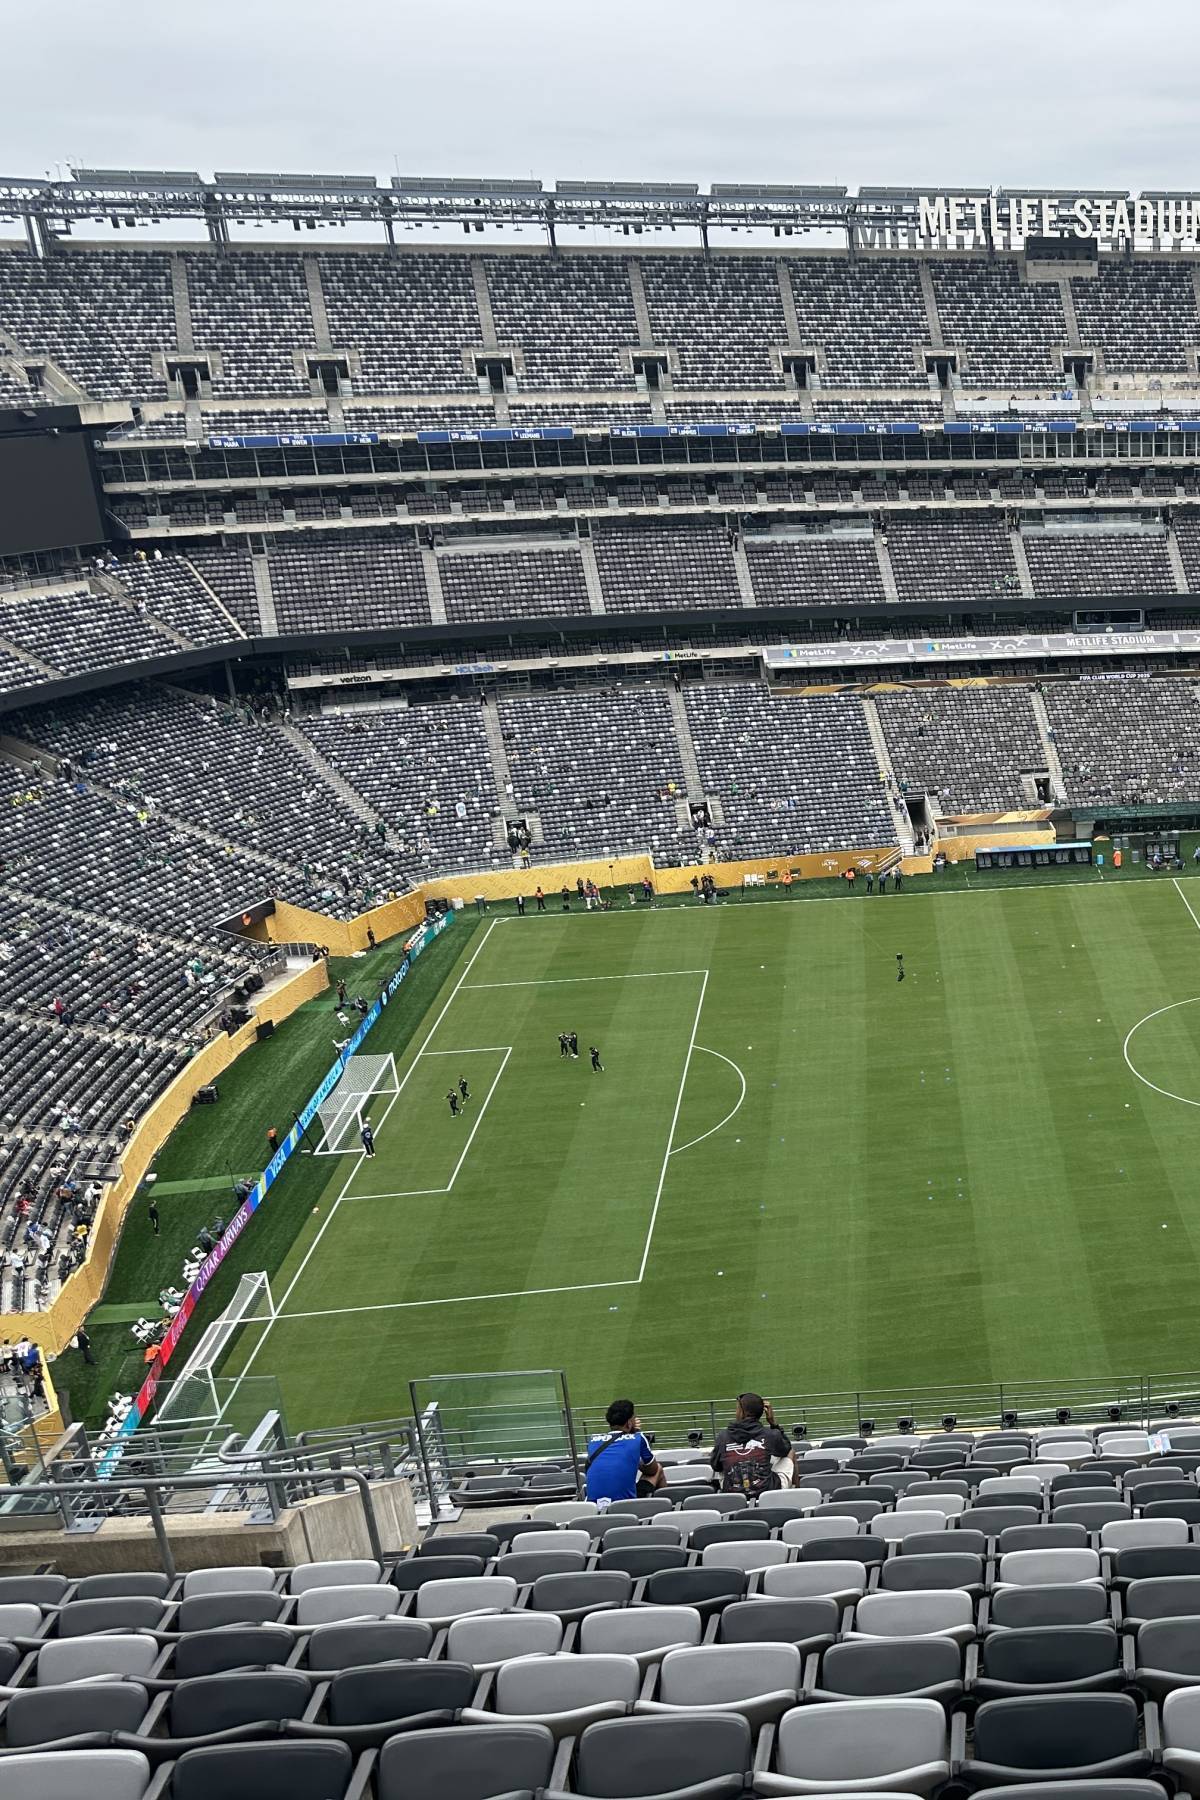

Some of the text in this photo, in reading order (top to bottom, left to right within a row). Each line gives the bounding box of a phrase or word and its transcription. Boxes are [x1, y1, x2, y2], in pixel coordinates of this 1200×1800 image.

[919, 196, 1059, 238] METLIFE
[941, 642, 976, 650] MetLife
[1066, 635, 1155, 647] METLIFE STADIUM
[674, 651, 698, 659] MetLife
[455, 666, 494, 674] HCLTech
[340, 675, 372, 683] verizon
[268, 1148, 287, 1178] VISA
[196, 1207, 249, 1292] QATAR AIRWAYS
